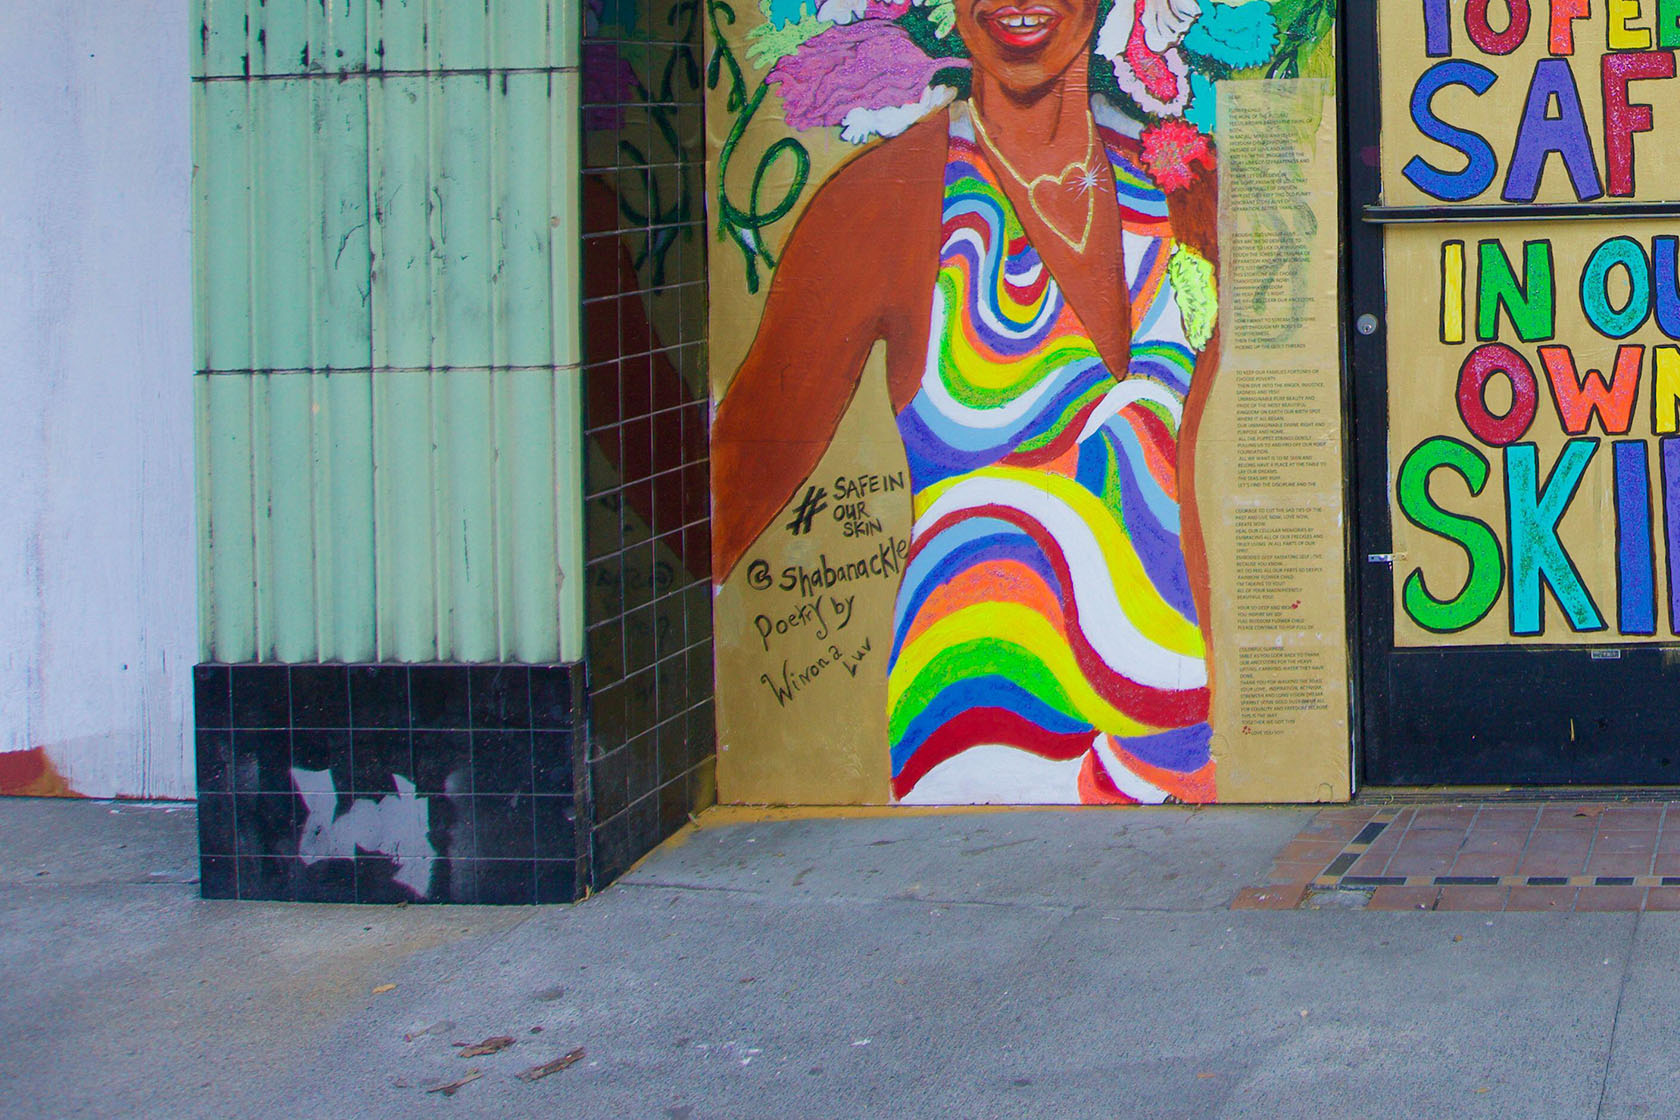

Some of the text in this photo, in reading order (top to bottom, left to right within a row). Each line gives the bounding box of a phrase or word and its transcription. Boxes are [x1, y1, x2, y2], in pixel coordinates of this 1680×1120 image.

[1439, 238, 1556, 344] IN
[833, 501, 870, 522] OUR
[842, 518, 883, 538] SKIN
[754, 595, 855, 652] Poetry by
[760, 636, 873, 708] Winona Luv
